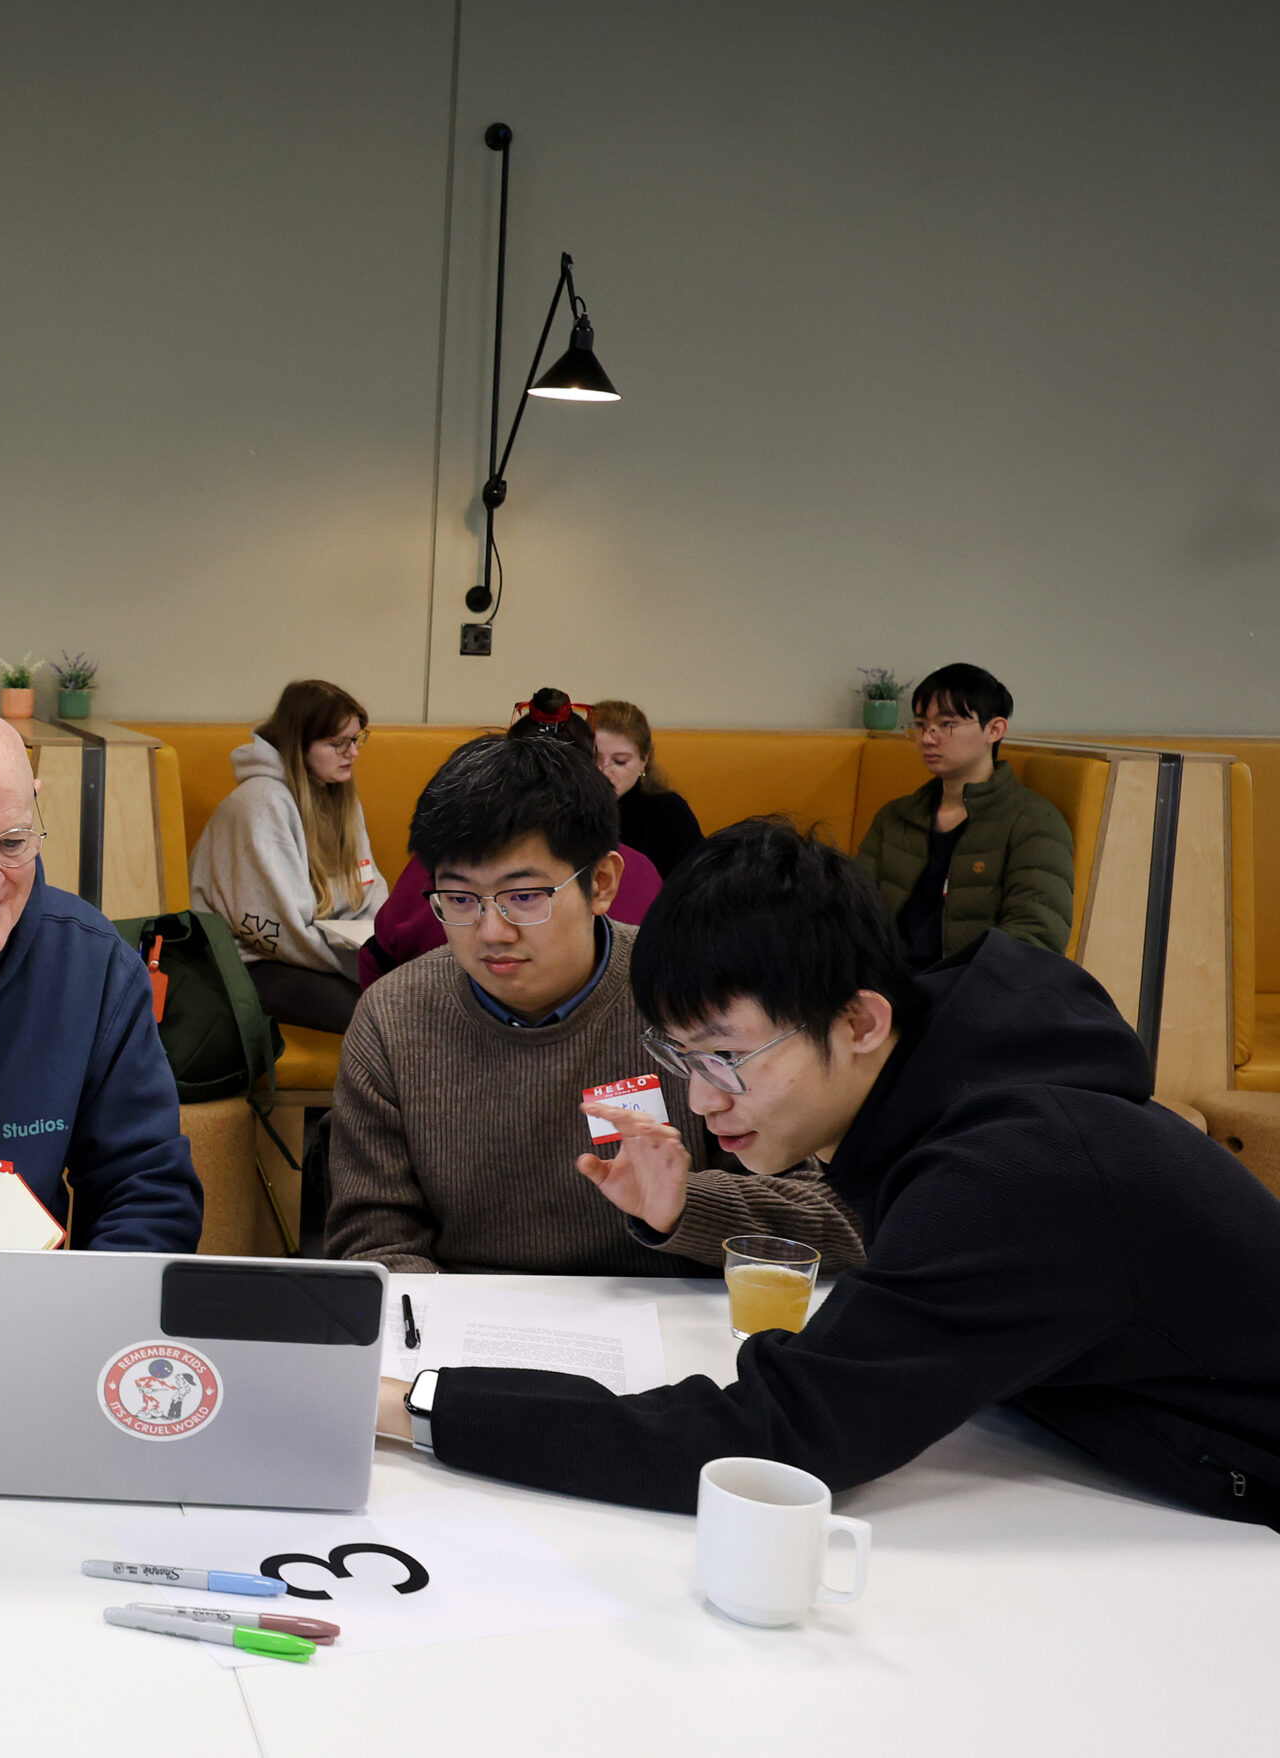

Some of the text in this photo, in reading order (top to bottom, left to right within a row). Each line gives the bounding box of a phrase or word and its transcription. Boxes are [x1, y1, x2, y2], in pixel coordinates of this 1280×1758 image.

[593, 1078, 647, 1096] HELLO
[3, 1118, 69, 1139] Studios.
[117, 1347, 207, 1374] REMEMBER KIDS
[110, 1401, 209, 1435] IT'S A CRUEL WORLD
[143, 1565, 180, 1581] Sharpie
[260, 1542, 430, 1601] 3
